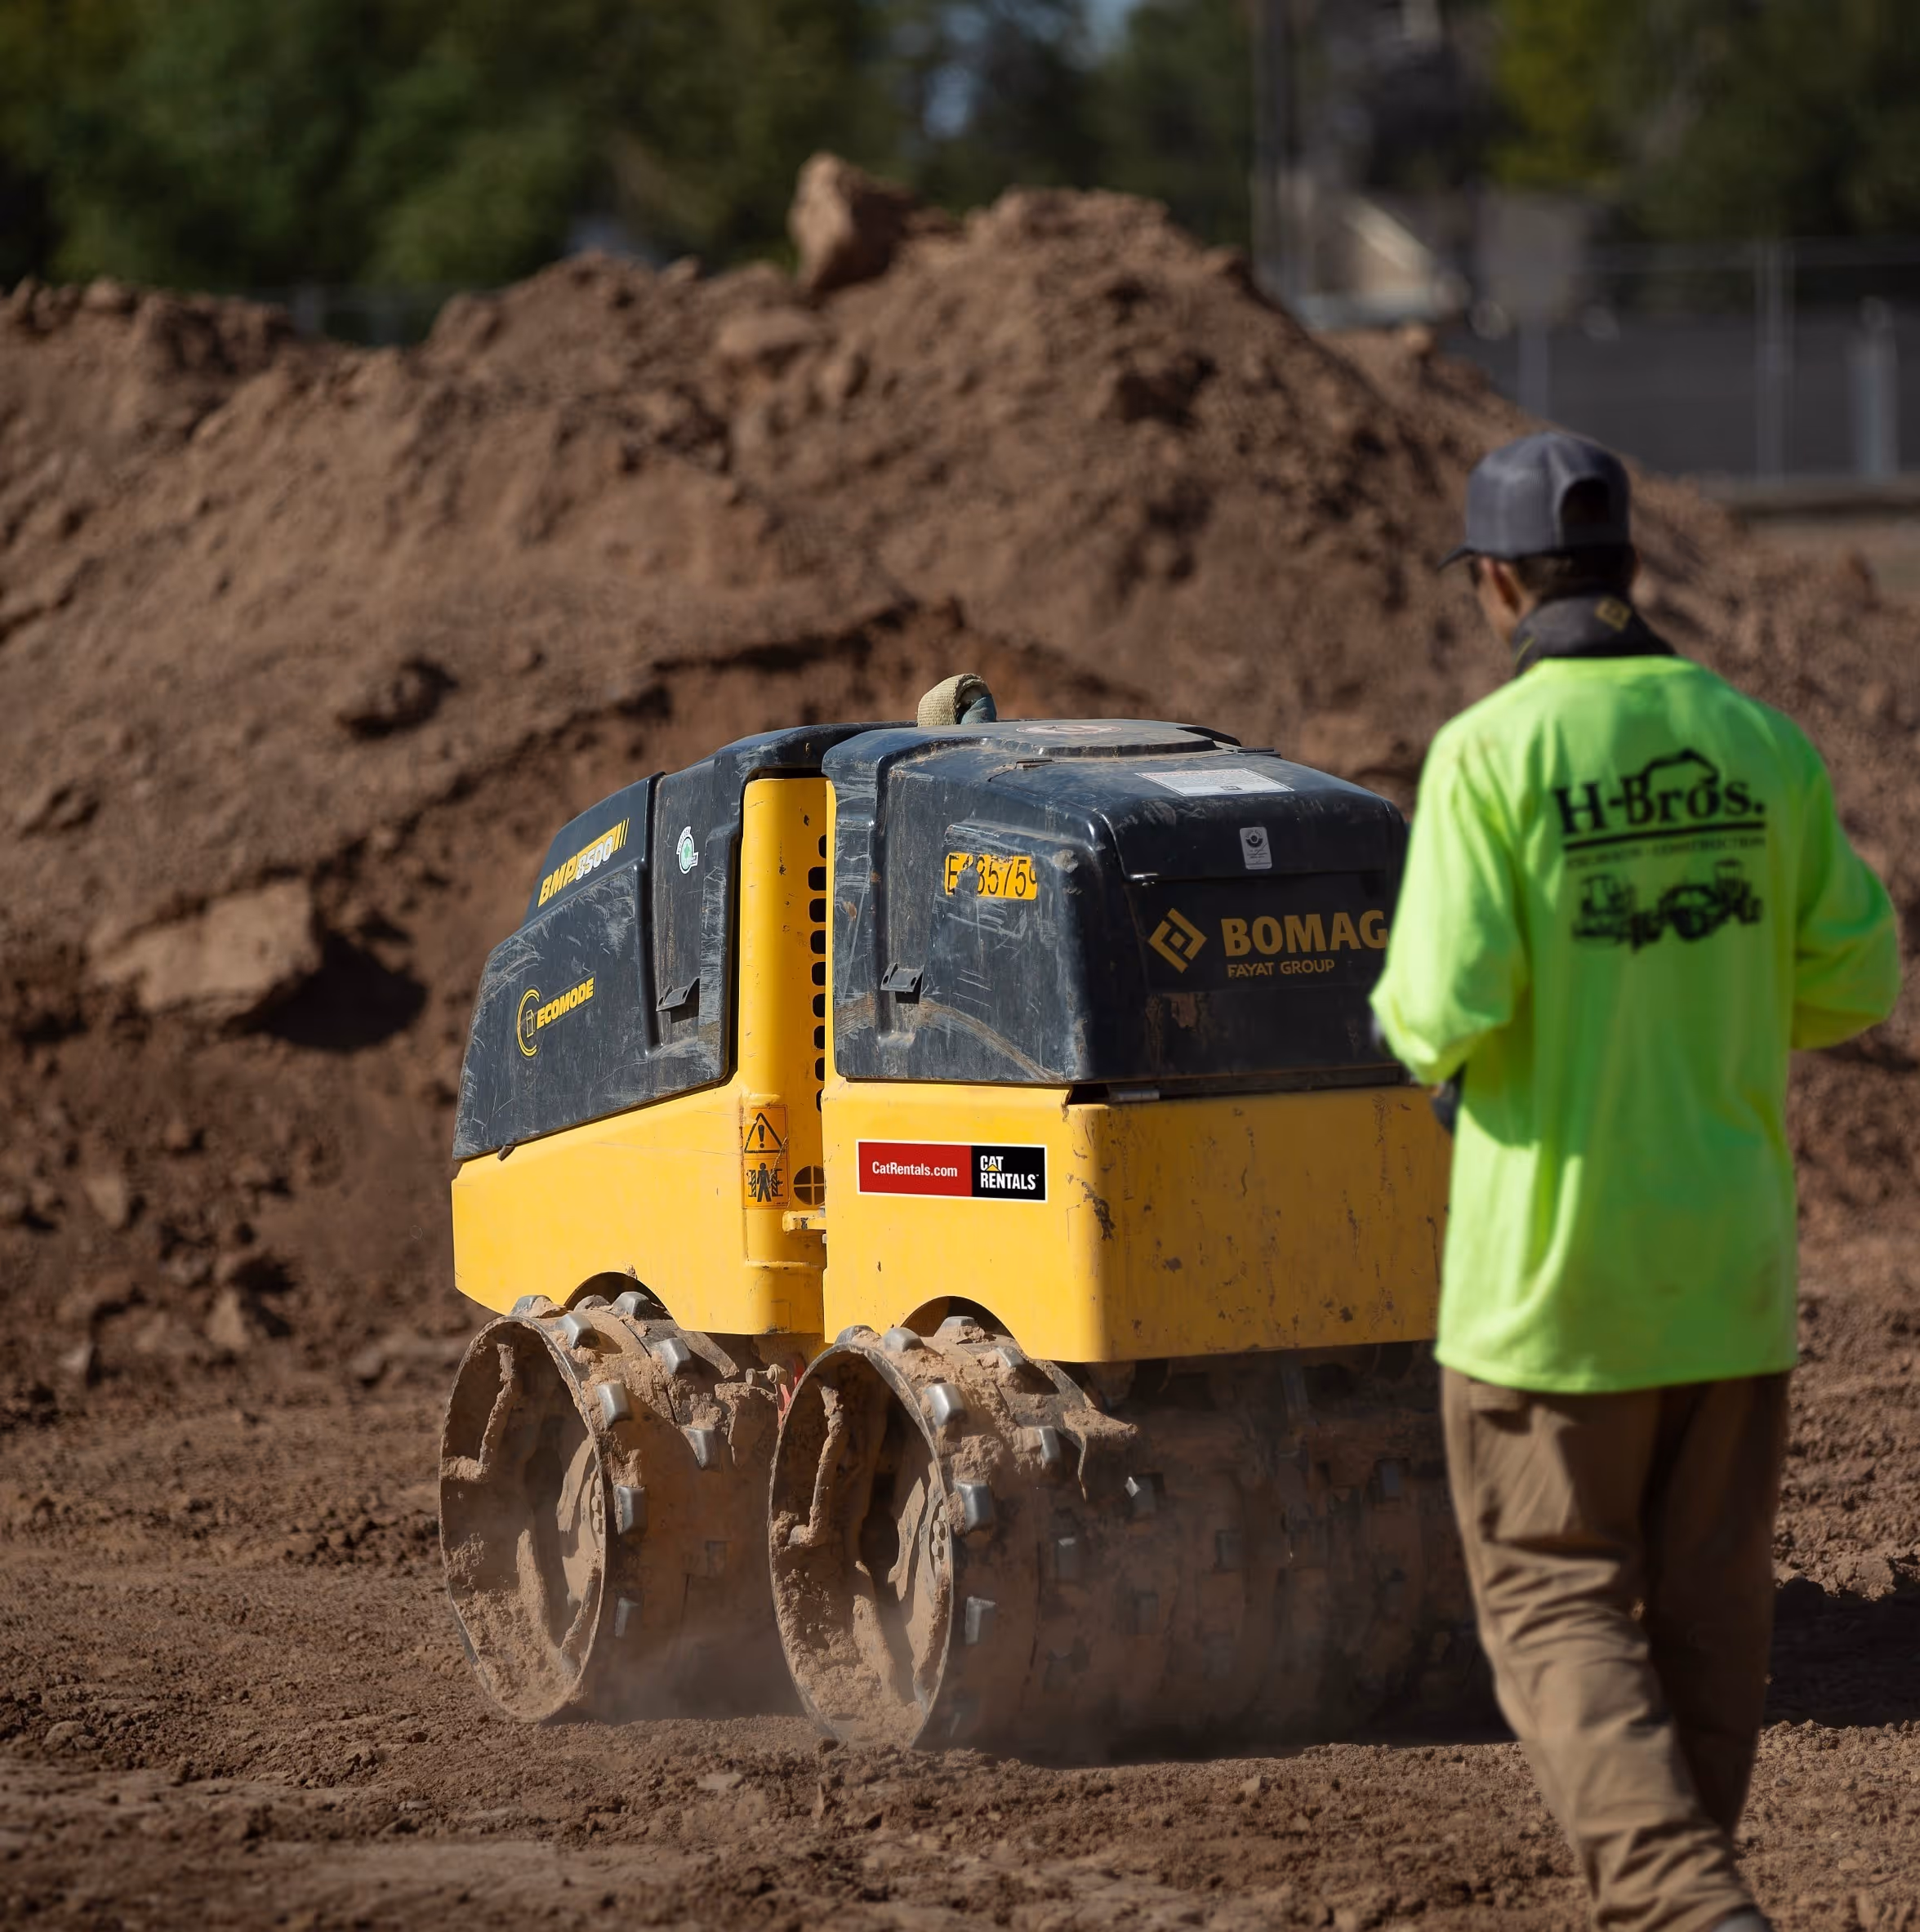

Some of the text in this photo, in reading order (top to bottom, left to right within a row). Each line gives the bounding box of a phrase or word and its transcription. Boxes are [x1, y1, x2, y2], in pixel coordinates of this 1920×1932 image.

[1553, 776, 1766, 835] H-Bros.
[1221, 910, 1388, 957] BOMAG
[1227, 959, 1335, 978] FAYAT GROUP
[536, 977, 595, 1030] ECOMODE
[872, 1160, 958, 1177] CatRentals.com
[980, 1155, 1004, 1172] CAT
[980, 1172, 1036, 1191] RENTALS
